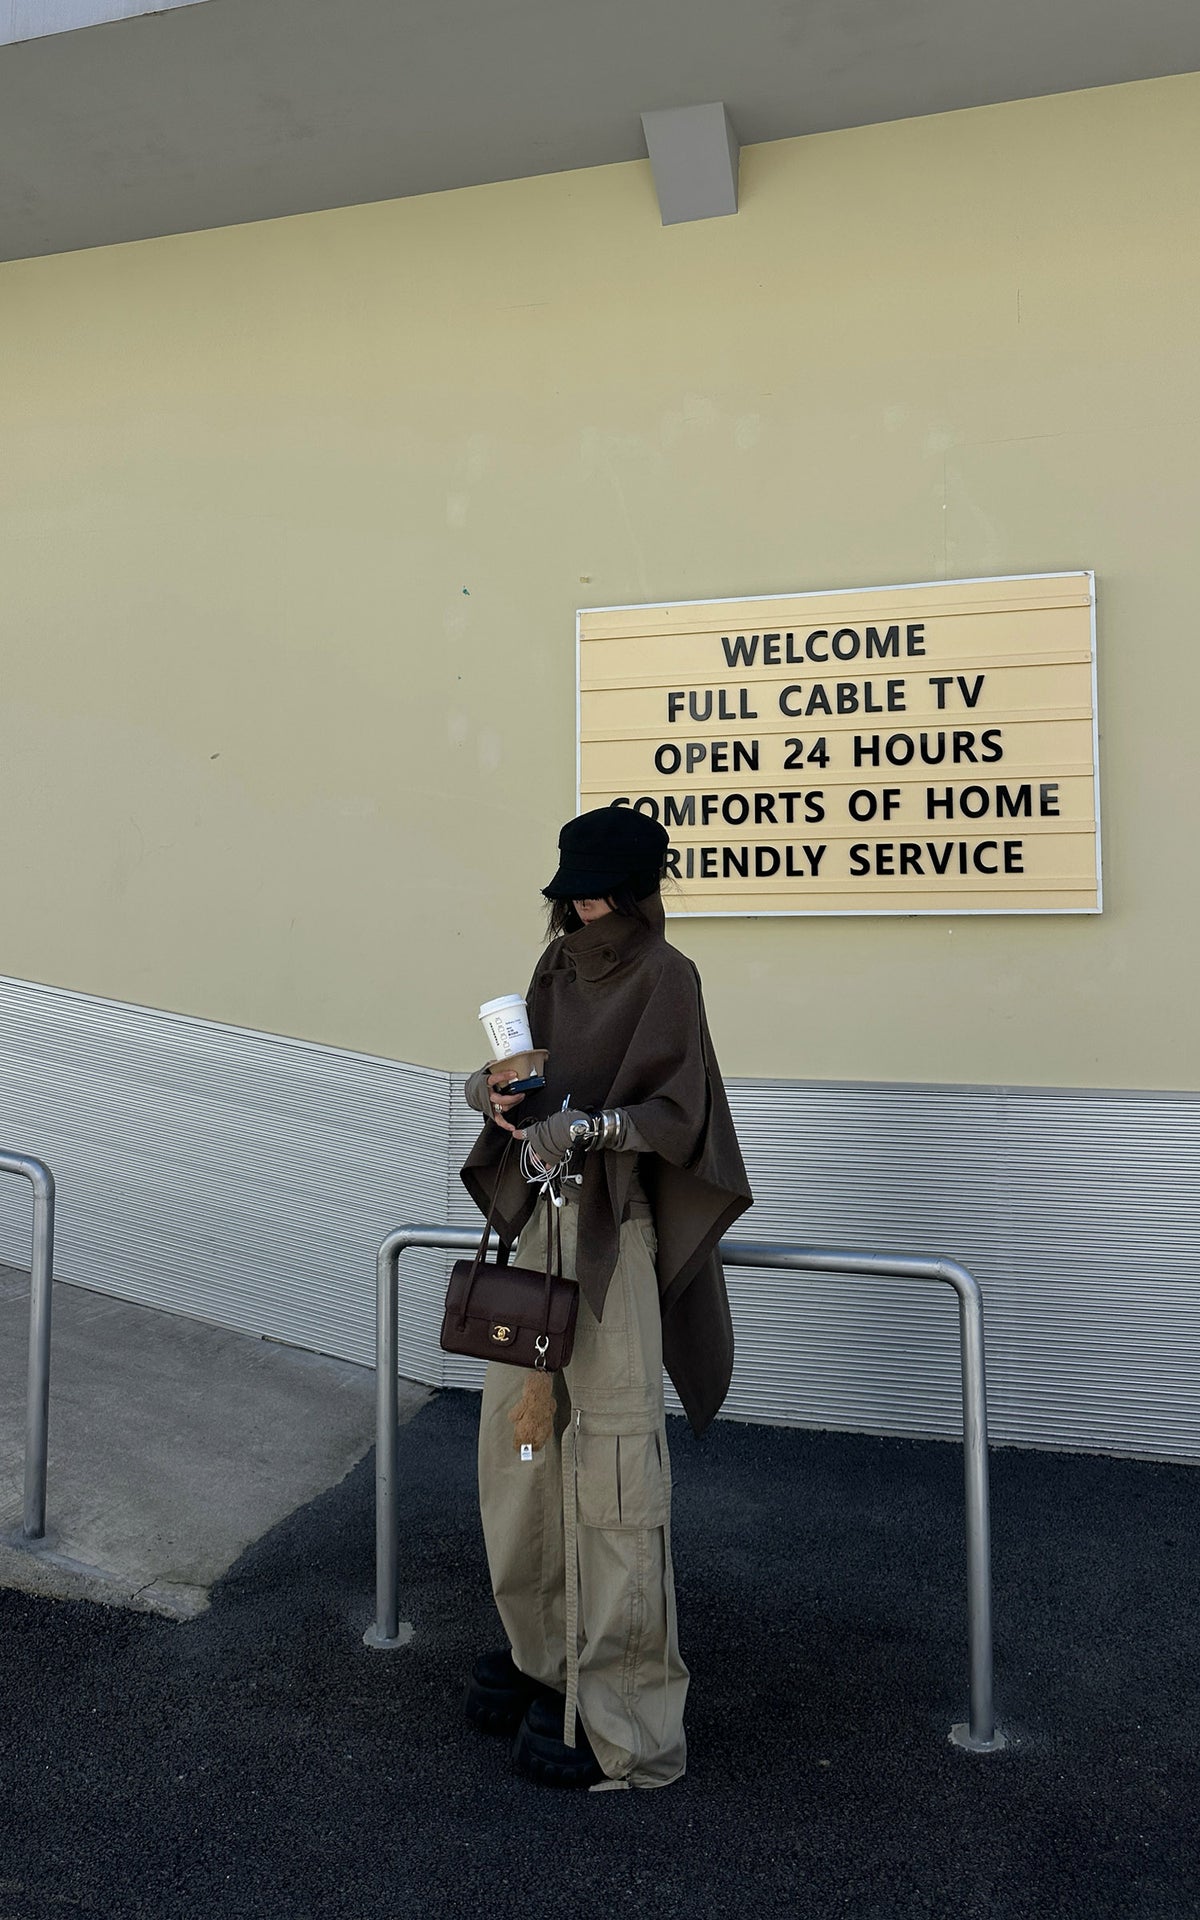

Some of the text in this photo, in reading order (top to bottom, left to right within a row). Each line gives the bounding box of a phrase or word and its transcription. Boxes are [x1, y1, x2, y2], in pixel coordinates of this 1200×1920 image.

[721, 624, 926, 667] WELCOME
[667, 675, 985, 722] FULL CABLE TV
[655, 729, 1004, 775] OPEN 24 HOURS
[849, 789, 901, 822] OF
[927, 784, 1060, 819] HOME
[664, 841, 1025, 880] RIENDLY SERVICE
